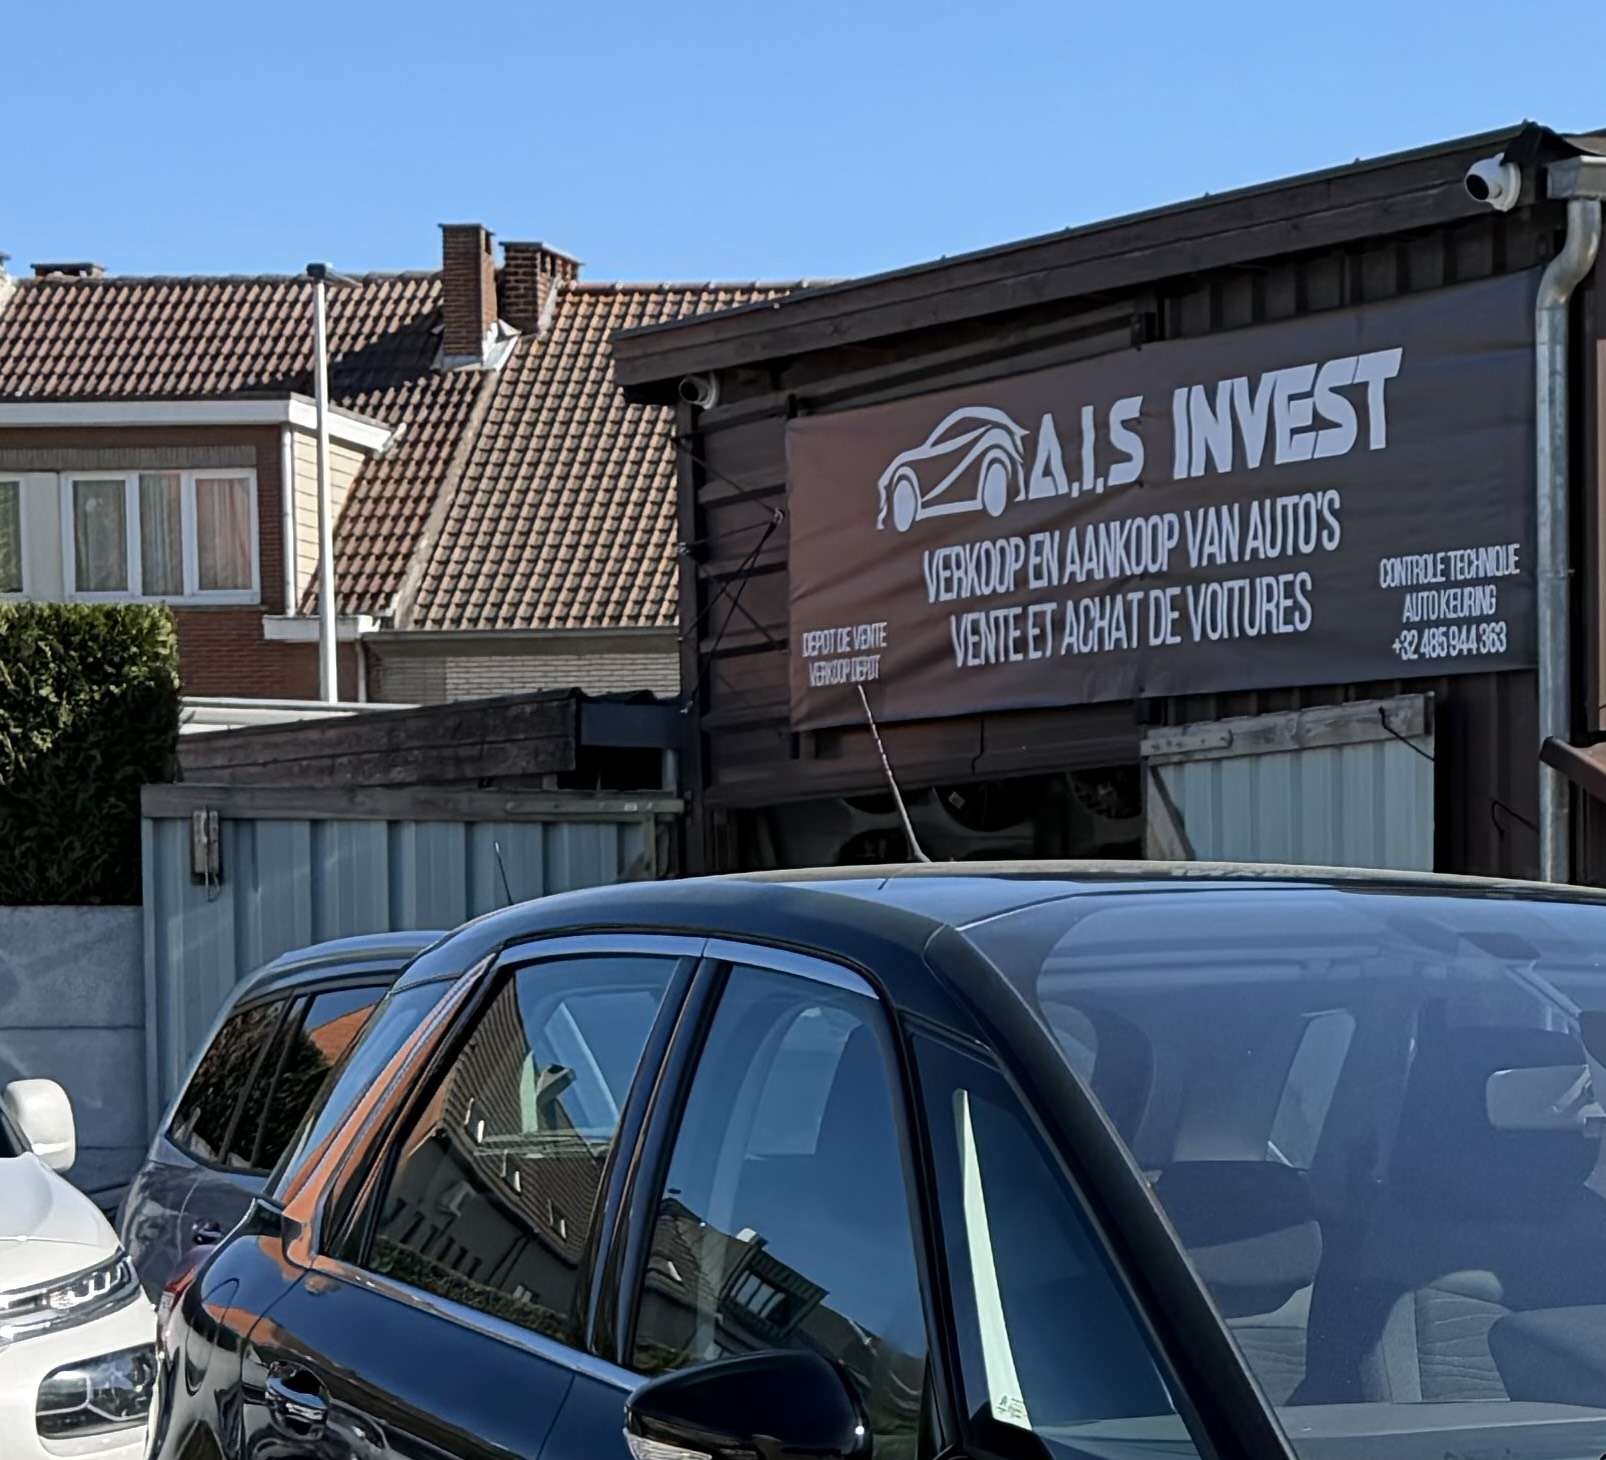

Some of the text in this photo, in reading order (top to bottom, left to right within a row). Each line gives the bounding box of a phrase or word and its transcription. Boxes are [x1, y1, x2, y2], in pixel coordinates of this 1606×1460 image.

[1028, 347, 1404, 499] A.I.S INVEST
[923, 489, 1341, 604] VERKOOP EN AANKOOP VAN AUTO'S
[1379, 543, 1521, 589] CONTROLE TECHNIQUE
[950, 571, 1313, 668] VENTE ET ACHAT DE VOITURES
[1402, 585, 1497, 624] AUTO KEURING
[802, 621, 888, 658] DEPOT DE VENTE
[1391, 620, 1508, 661] +32 485 944 363
